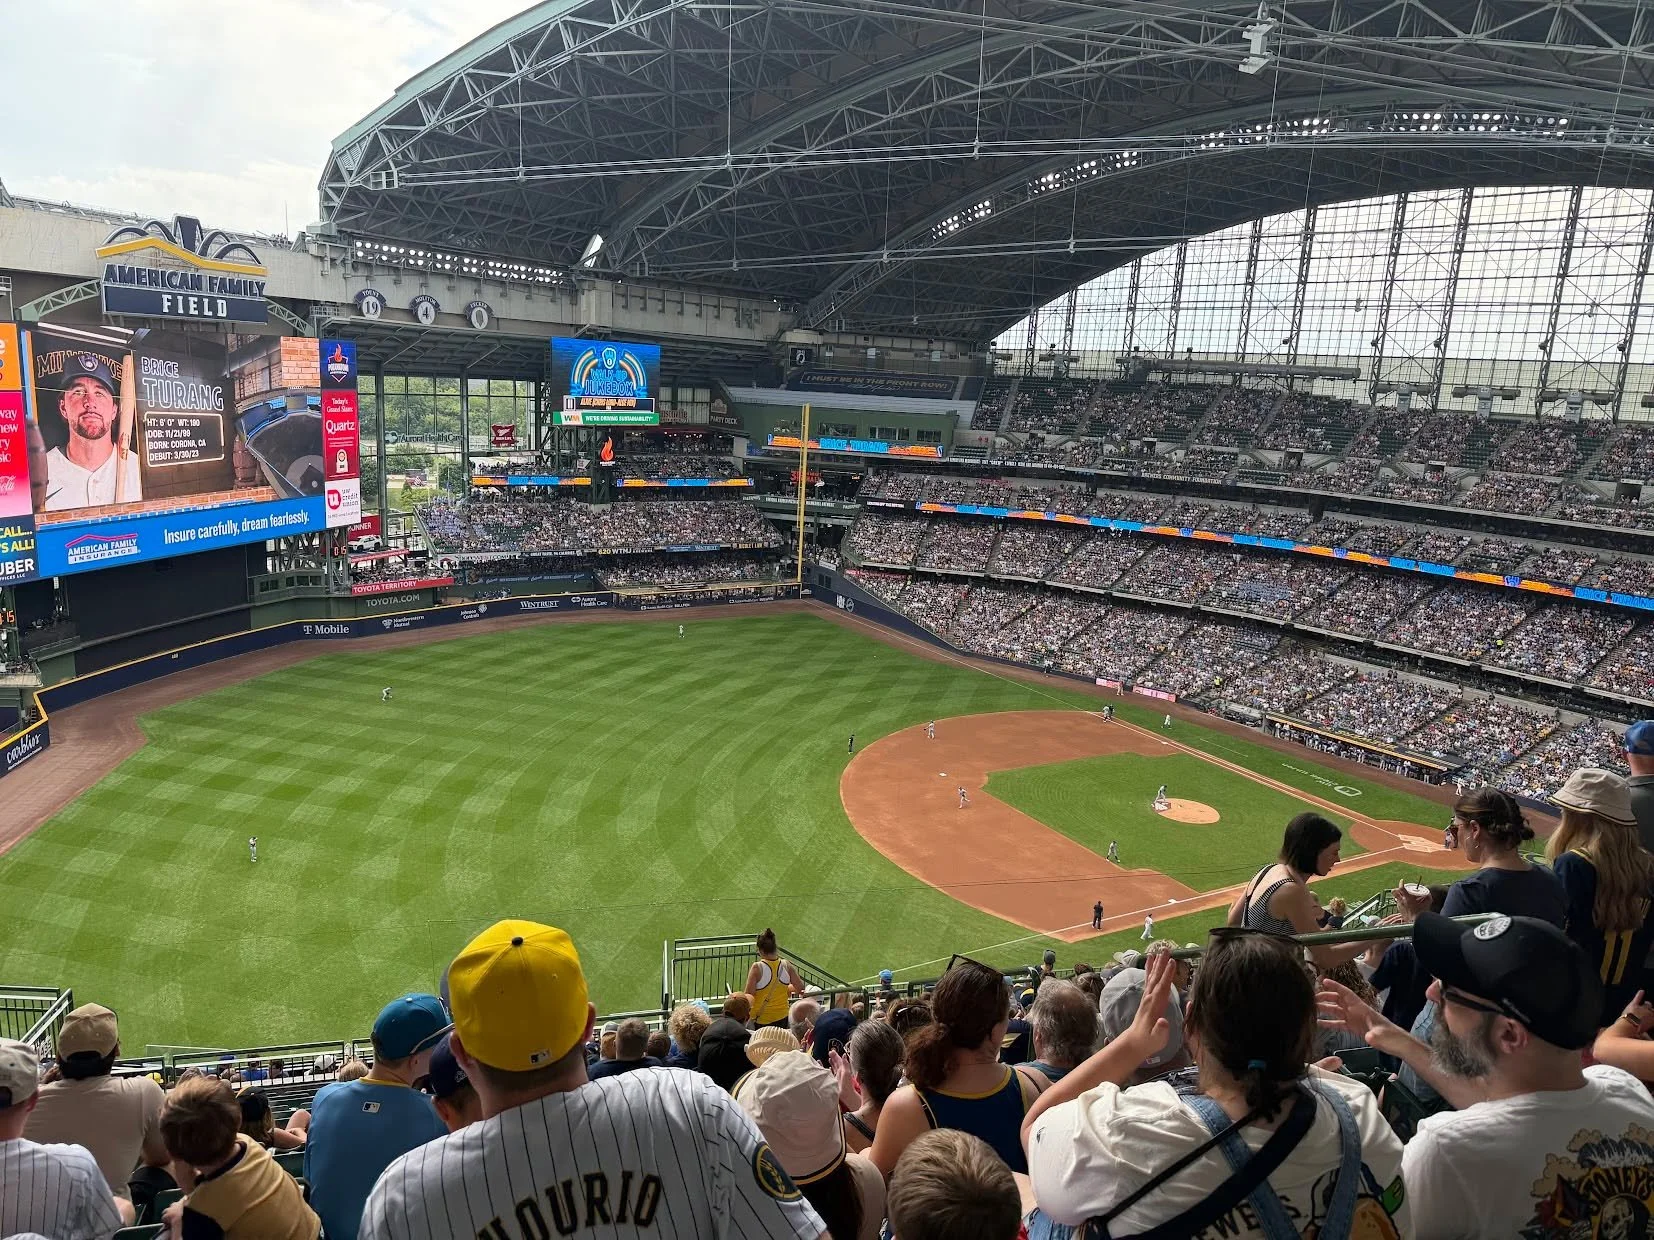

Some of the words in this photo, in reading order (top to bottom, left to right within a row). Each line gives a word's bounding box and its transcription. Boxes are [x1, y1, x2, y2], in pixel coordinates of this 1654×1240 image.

[102, 263, 202, 291] AMERICAN
[208, 276, 266, 298] FAMILY
[161, 294, 227, 317] FIELD
[365, 301, 378, 315] 19
[422, 306, 429, 319] 4
[141, 356, 179, 378] BRICE
[142, 378, 224, 411] TURANG
[585, 380, 633, 396] JUKEBOX
[147, 418, 158, 427] HT:
[178, 418, 190, 427] WT:
[190, 418, 200, 427] 190
[326, 420, 355, 434] Quartz
[147, 430, 164, 438] DOB:
[148, 440, 169, 449] BORN:
[170, 440, 197, 449] CORONA,
[198, 439, 206, 447] CA
[150, 452, 173, 461] DEBUT:
[174, 450, 199, 459] 3/30/23
[164, 528, 196, 544] Insure
[198, 520, 240, 539] carefully,
[241, 517, 268, 532] dream
[270, 509, 310, 527] fearlessly.
[11, 538, 35, 553] ALL!
[68, 542, 108, 556] AMERICAN
[110, 538, 137, 550] FAMILY
[74, 548, 133, 562] INSURANCE
[353, 585, 380, 593] TOYOTA
[381, 581, 417, 591] TERRITORY
[366, 594, 420, 607] TOYOTA.COM
[314, 624, 349, 634] Mobile
